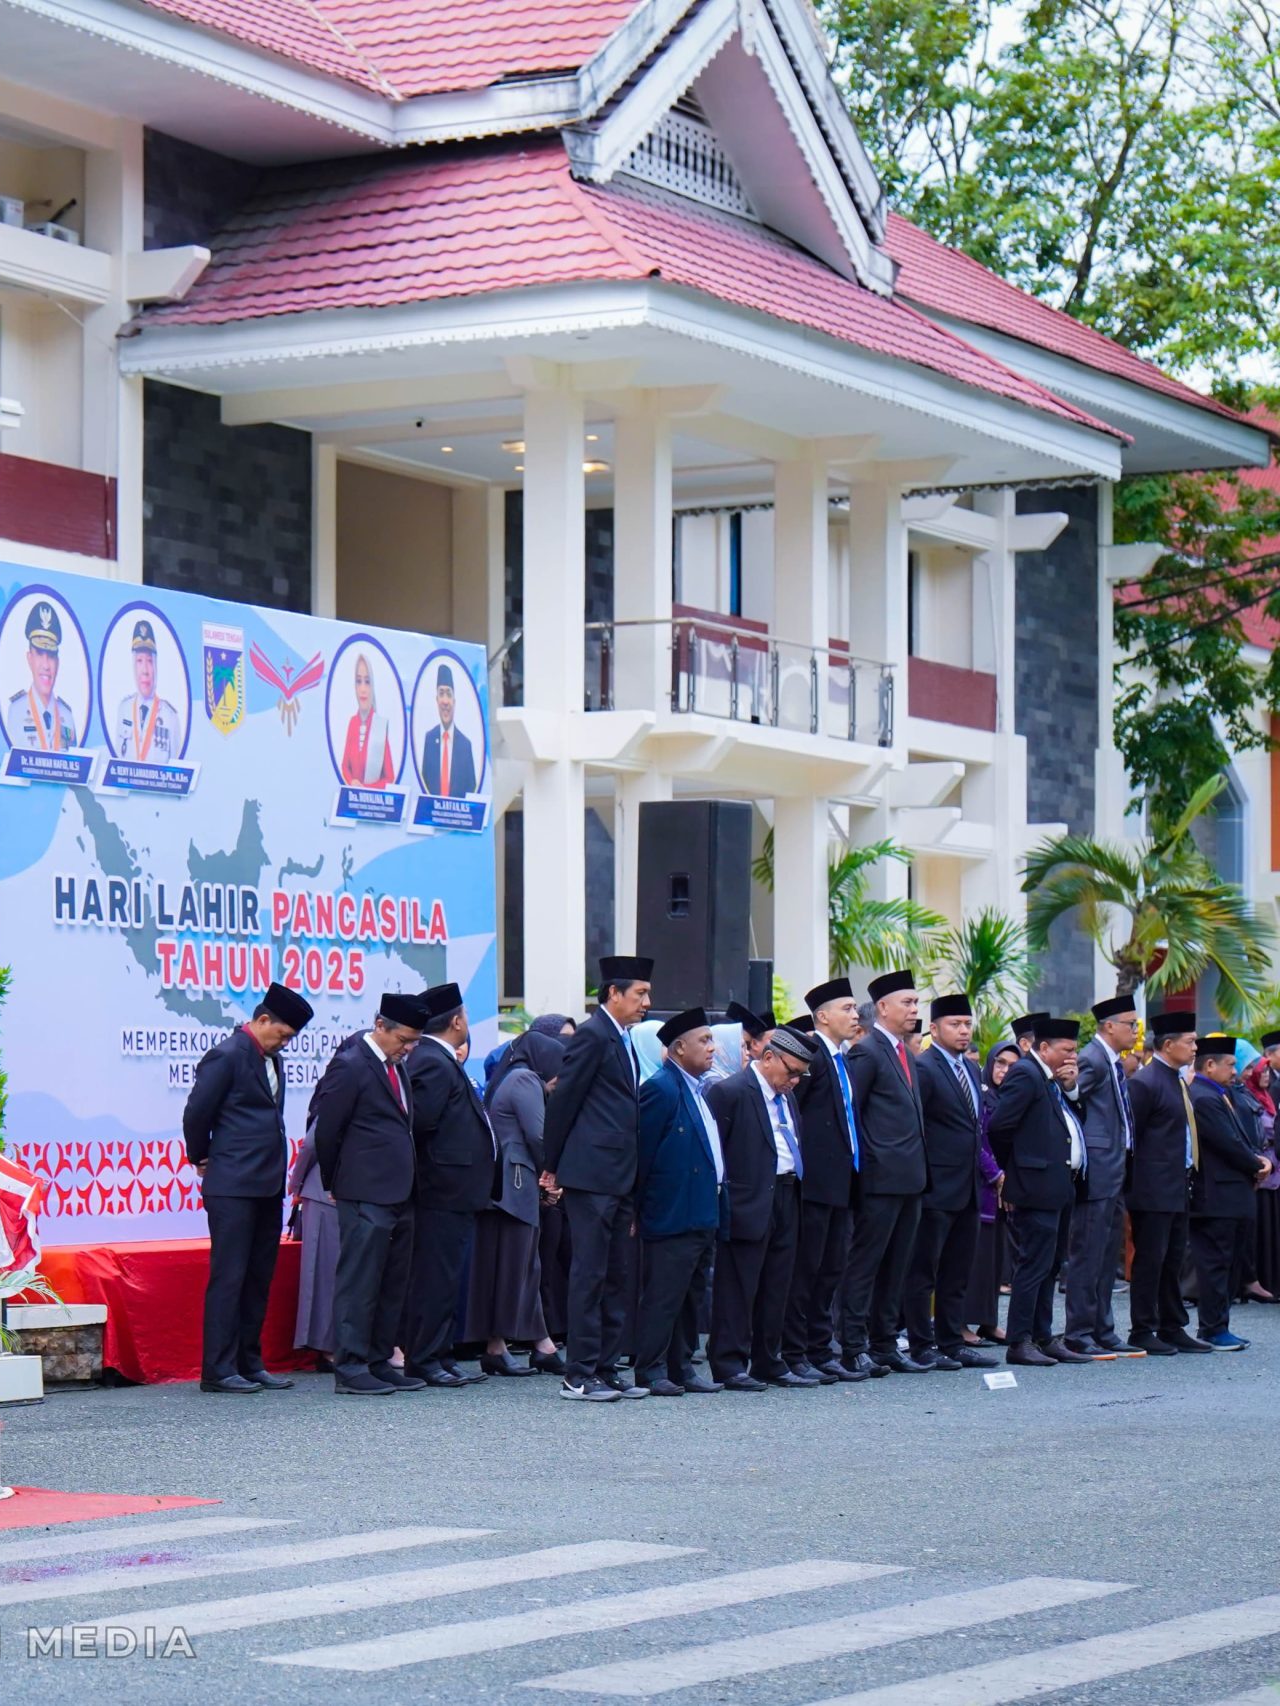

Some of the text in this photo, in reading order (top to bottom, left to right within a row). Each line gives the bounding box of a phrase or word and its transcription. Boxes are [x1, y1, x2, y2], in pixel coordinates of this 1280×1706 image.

[55, 876, 447, 941] HARI LAHIR PANCASILA
[158, 943, 365, 991] TAHUN 2025
